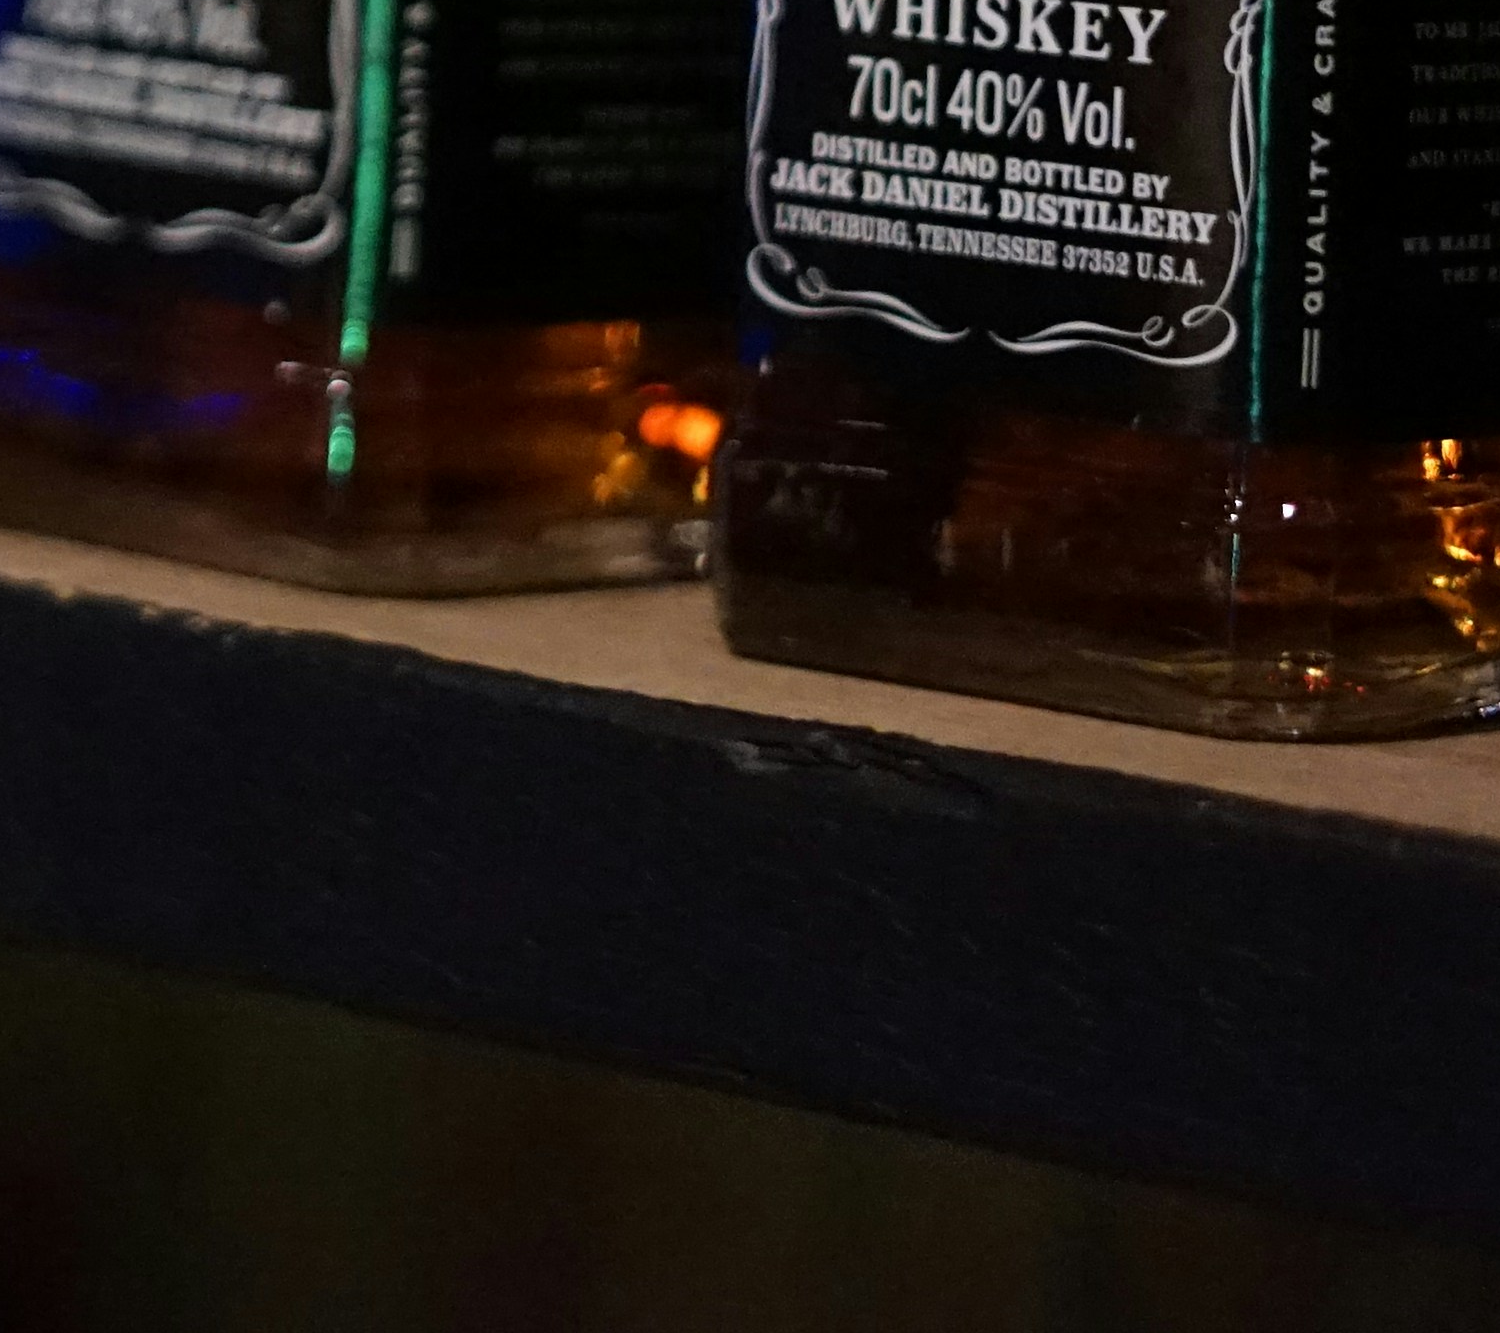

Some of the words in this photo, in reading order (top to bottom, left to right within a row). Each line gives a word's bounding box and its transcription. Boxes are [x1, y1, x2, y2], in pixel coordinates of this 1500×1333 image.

[847, 54, 938, 129] 70cl
[946, 69, 1045, 143] 40%
[1056, 79, 1137, 152] Vol.
[1309, 90, 1336, 116] &
[769, 157, 857, 199] JACK
[861, 170, 990, 218] DANIEL
[998, 185, 1220, 246] DISTILLERY
[811, 132, 938, 174] DISTILLED
[942, 148, 999, 182] AND
[1004, 156, 1124, 196] BOTTLED
[1131, 173, 1172, 202] BY
[772, 201, 914, 250] LYNCHBURG,
[916, 221, 1058, 268] TENNESSEE
[1061, 242, 1132, 277] 37352
[1136, 250, 1206, 286] U.S.A.
[1301, 129, 1332, 317] QUALITY
